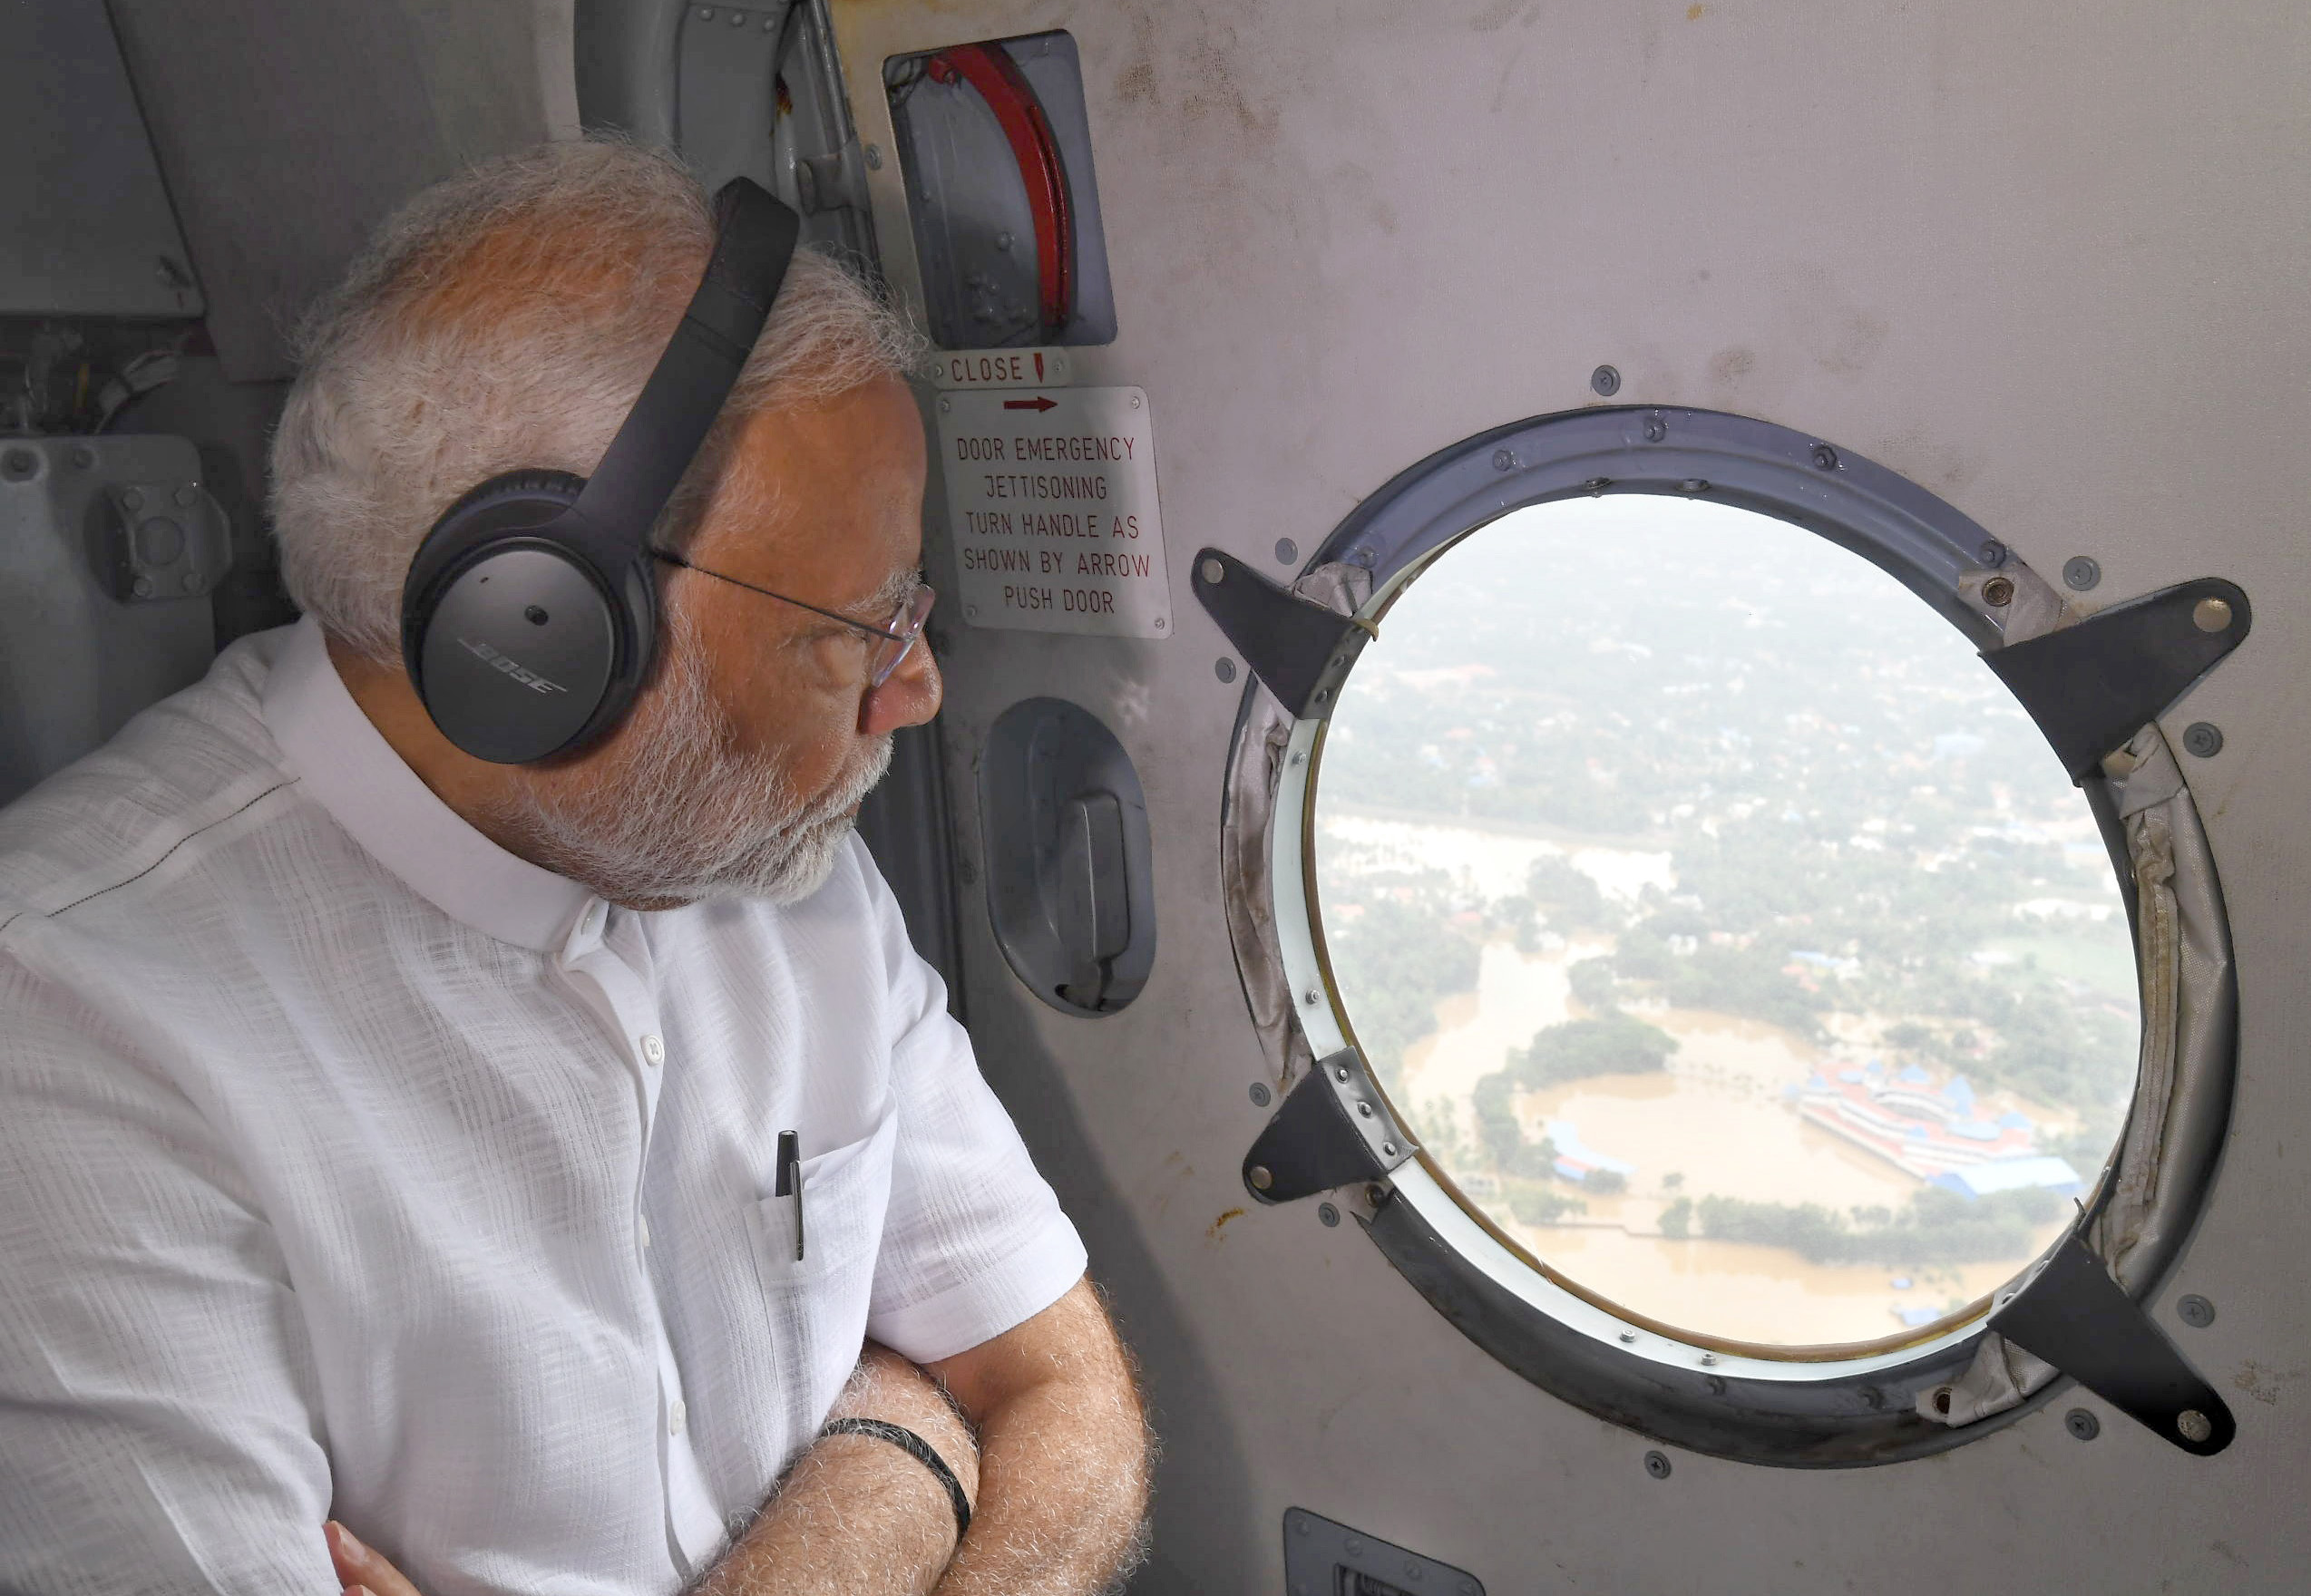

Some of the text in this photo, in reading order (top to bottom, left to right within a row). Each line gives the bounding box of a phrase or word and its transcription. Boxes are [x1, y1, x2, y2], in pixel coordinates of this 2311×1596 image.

[951, 356, 1024, 382] CLOSE
[957, 436, 1135, 461] DOOR EMERGENCY
[983, 475, 1107, 500] JETTISONING
[965, 511, 1139, 540] TURN HANDLE AS
[964, 548, 1150, 578] SHOWN BY ARROW
[1004, 586, 1115, 614] PUSH DOOR
